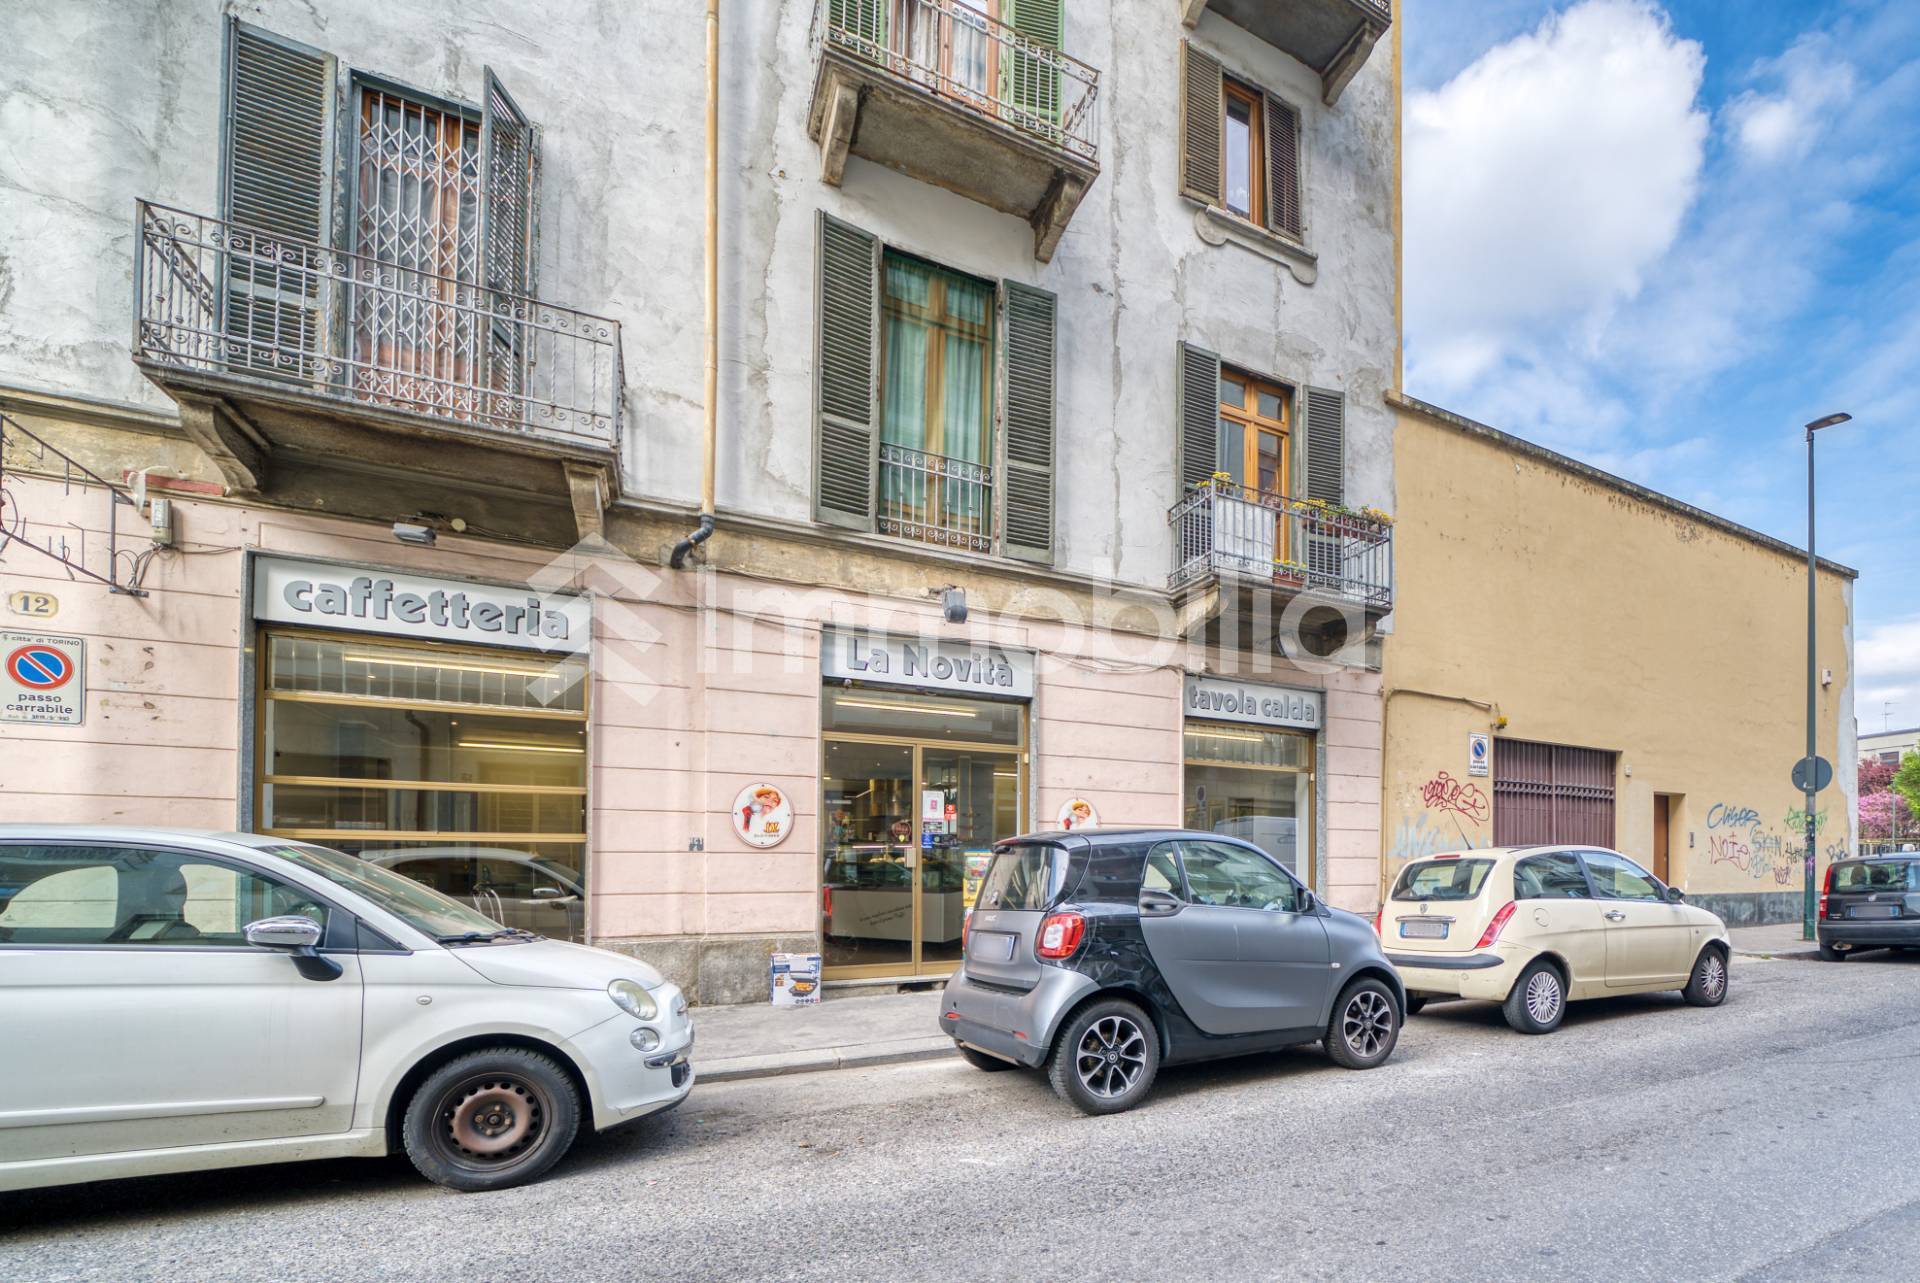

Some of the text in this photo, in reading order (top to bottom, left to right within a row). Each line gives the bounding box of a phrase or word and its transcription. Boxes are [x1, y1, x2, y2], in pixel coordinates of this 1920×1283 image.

[20, 595, 49, 613] 12
[283, 577, 569, 640] caffetteria
[47, 638, 80, 646] TORINO
[847, 635, 1013, 687] La Novità
[18, 694, 62, 703] passo
[1188, 685, 1315, 722] tavola calda
[6, 704, 73, 714] carrabile
